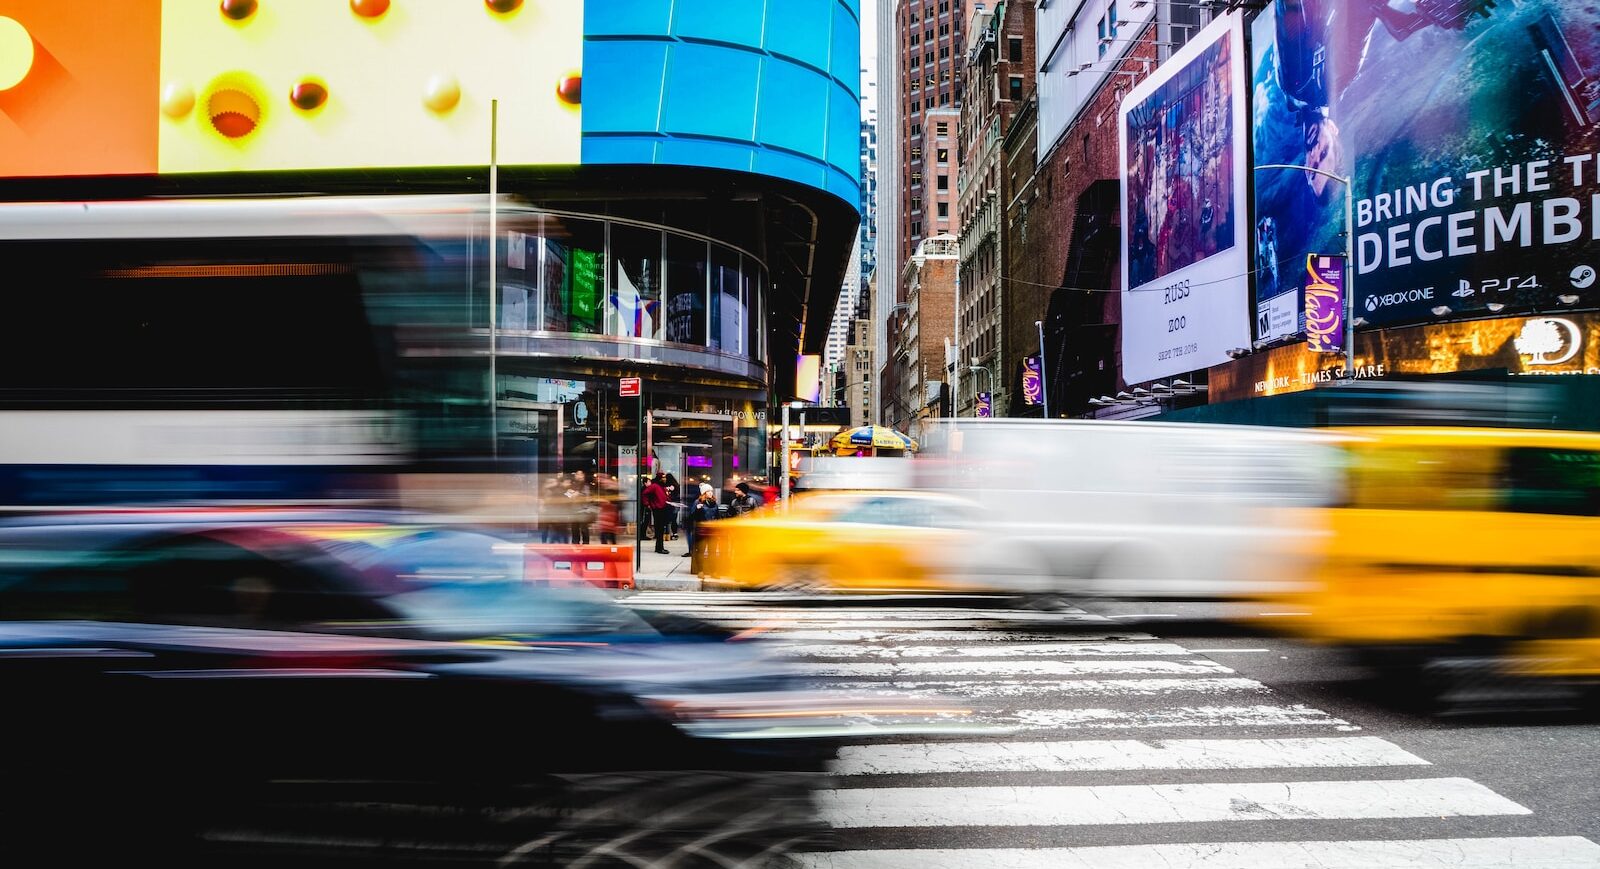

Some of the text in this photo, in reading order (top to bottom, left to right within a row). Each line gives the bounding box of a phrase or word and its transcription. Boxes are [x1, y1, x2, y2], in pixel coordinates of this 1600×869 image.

[1357, 153, 1600, 228] BRING THE T
[1357, 193, 1600, 275] DECEMB
[1164, 279, 1190, 304] RUSS
[1481, 275, 1539, 294] PS4
[1379, 287, 1434, 307] XBOX ONE
[1168, 315, 1186, 333] ZOO
[1158, 343, 1198, 361] SEPT 7TH 2018
[1301, 369, 1331, 385] TIMES
